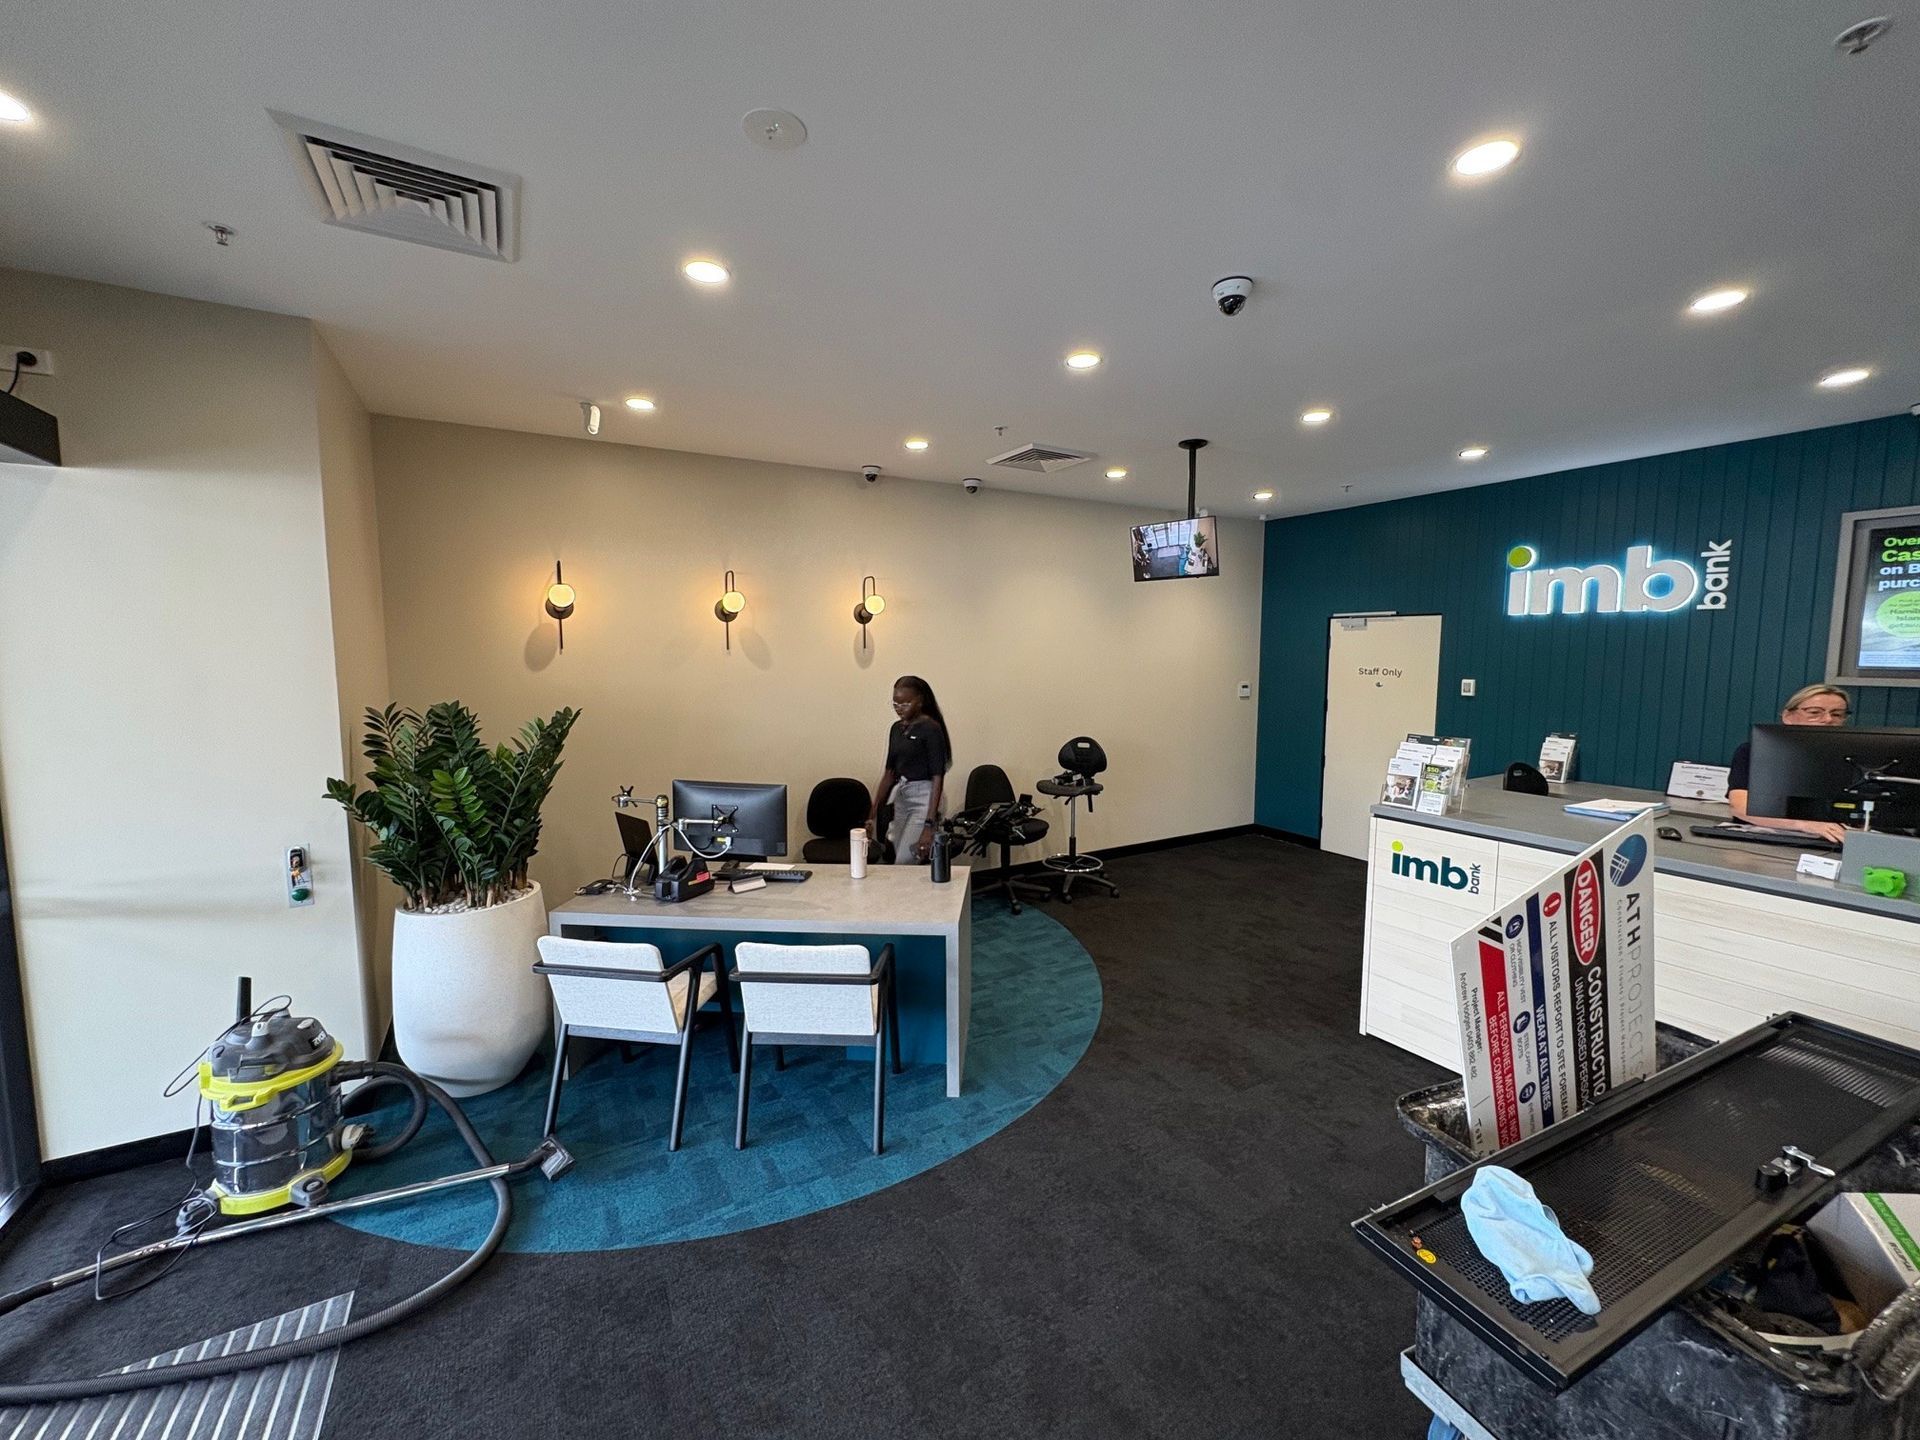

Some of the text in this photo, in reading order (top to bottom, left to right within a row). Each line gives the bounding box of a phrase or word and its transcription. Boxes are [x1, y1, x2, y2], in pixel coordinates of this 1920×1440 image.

[1507, 539, 1732, 615] imb bank
[1880, 566, 1903, 575] on
[1358, 667, 1403, 678] Staff Only
[1391, 840, 1481, 894] imb bank
[1578, 869, 1594, 956] DANGER
[1549, 920, 1557, 943] ALL
[1550, 941, 1560, 992] VISITORS
[1460, 972, 1468, 1001] Andrew
[1471, 986, 1479, 1018] Project
[1496, 990, 1505, 1012] ALL
[1463, 1000, 1471, 1032] Hodges
[1553, 991, 1564, 1036] REPORT
[1466, 1030, 1474, 1051] 0403
[1489, 1014, 1500, 1057] BEFORE
[1498, 1010, 1511, 1074] PERSONNEL
[1556, 1032, 1564, 1049] TO
[1535, 1003, 1552, 1111] WEAR AT ALL TIMES
[1557, 1048, 1566, 1072] SITE
[1493, 1057, 1507, 1127] COMMENCING
[1504, 1073, 1515, 1104] MUST
[1507, 1103, 1516, 1118] BE
